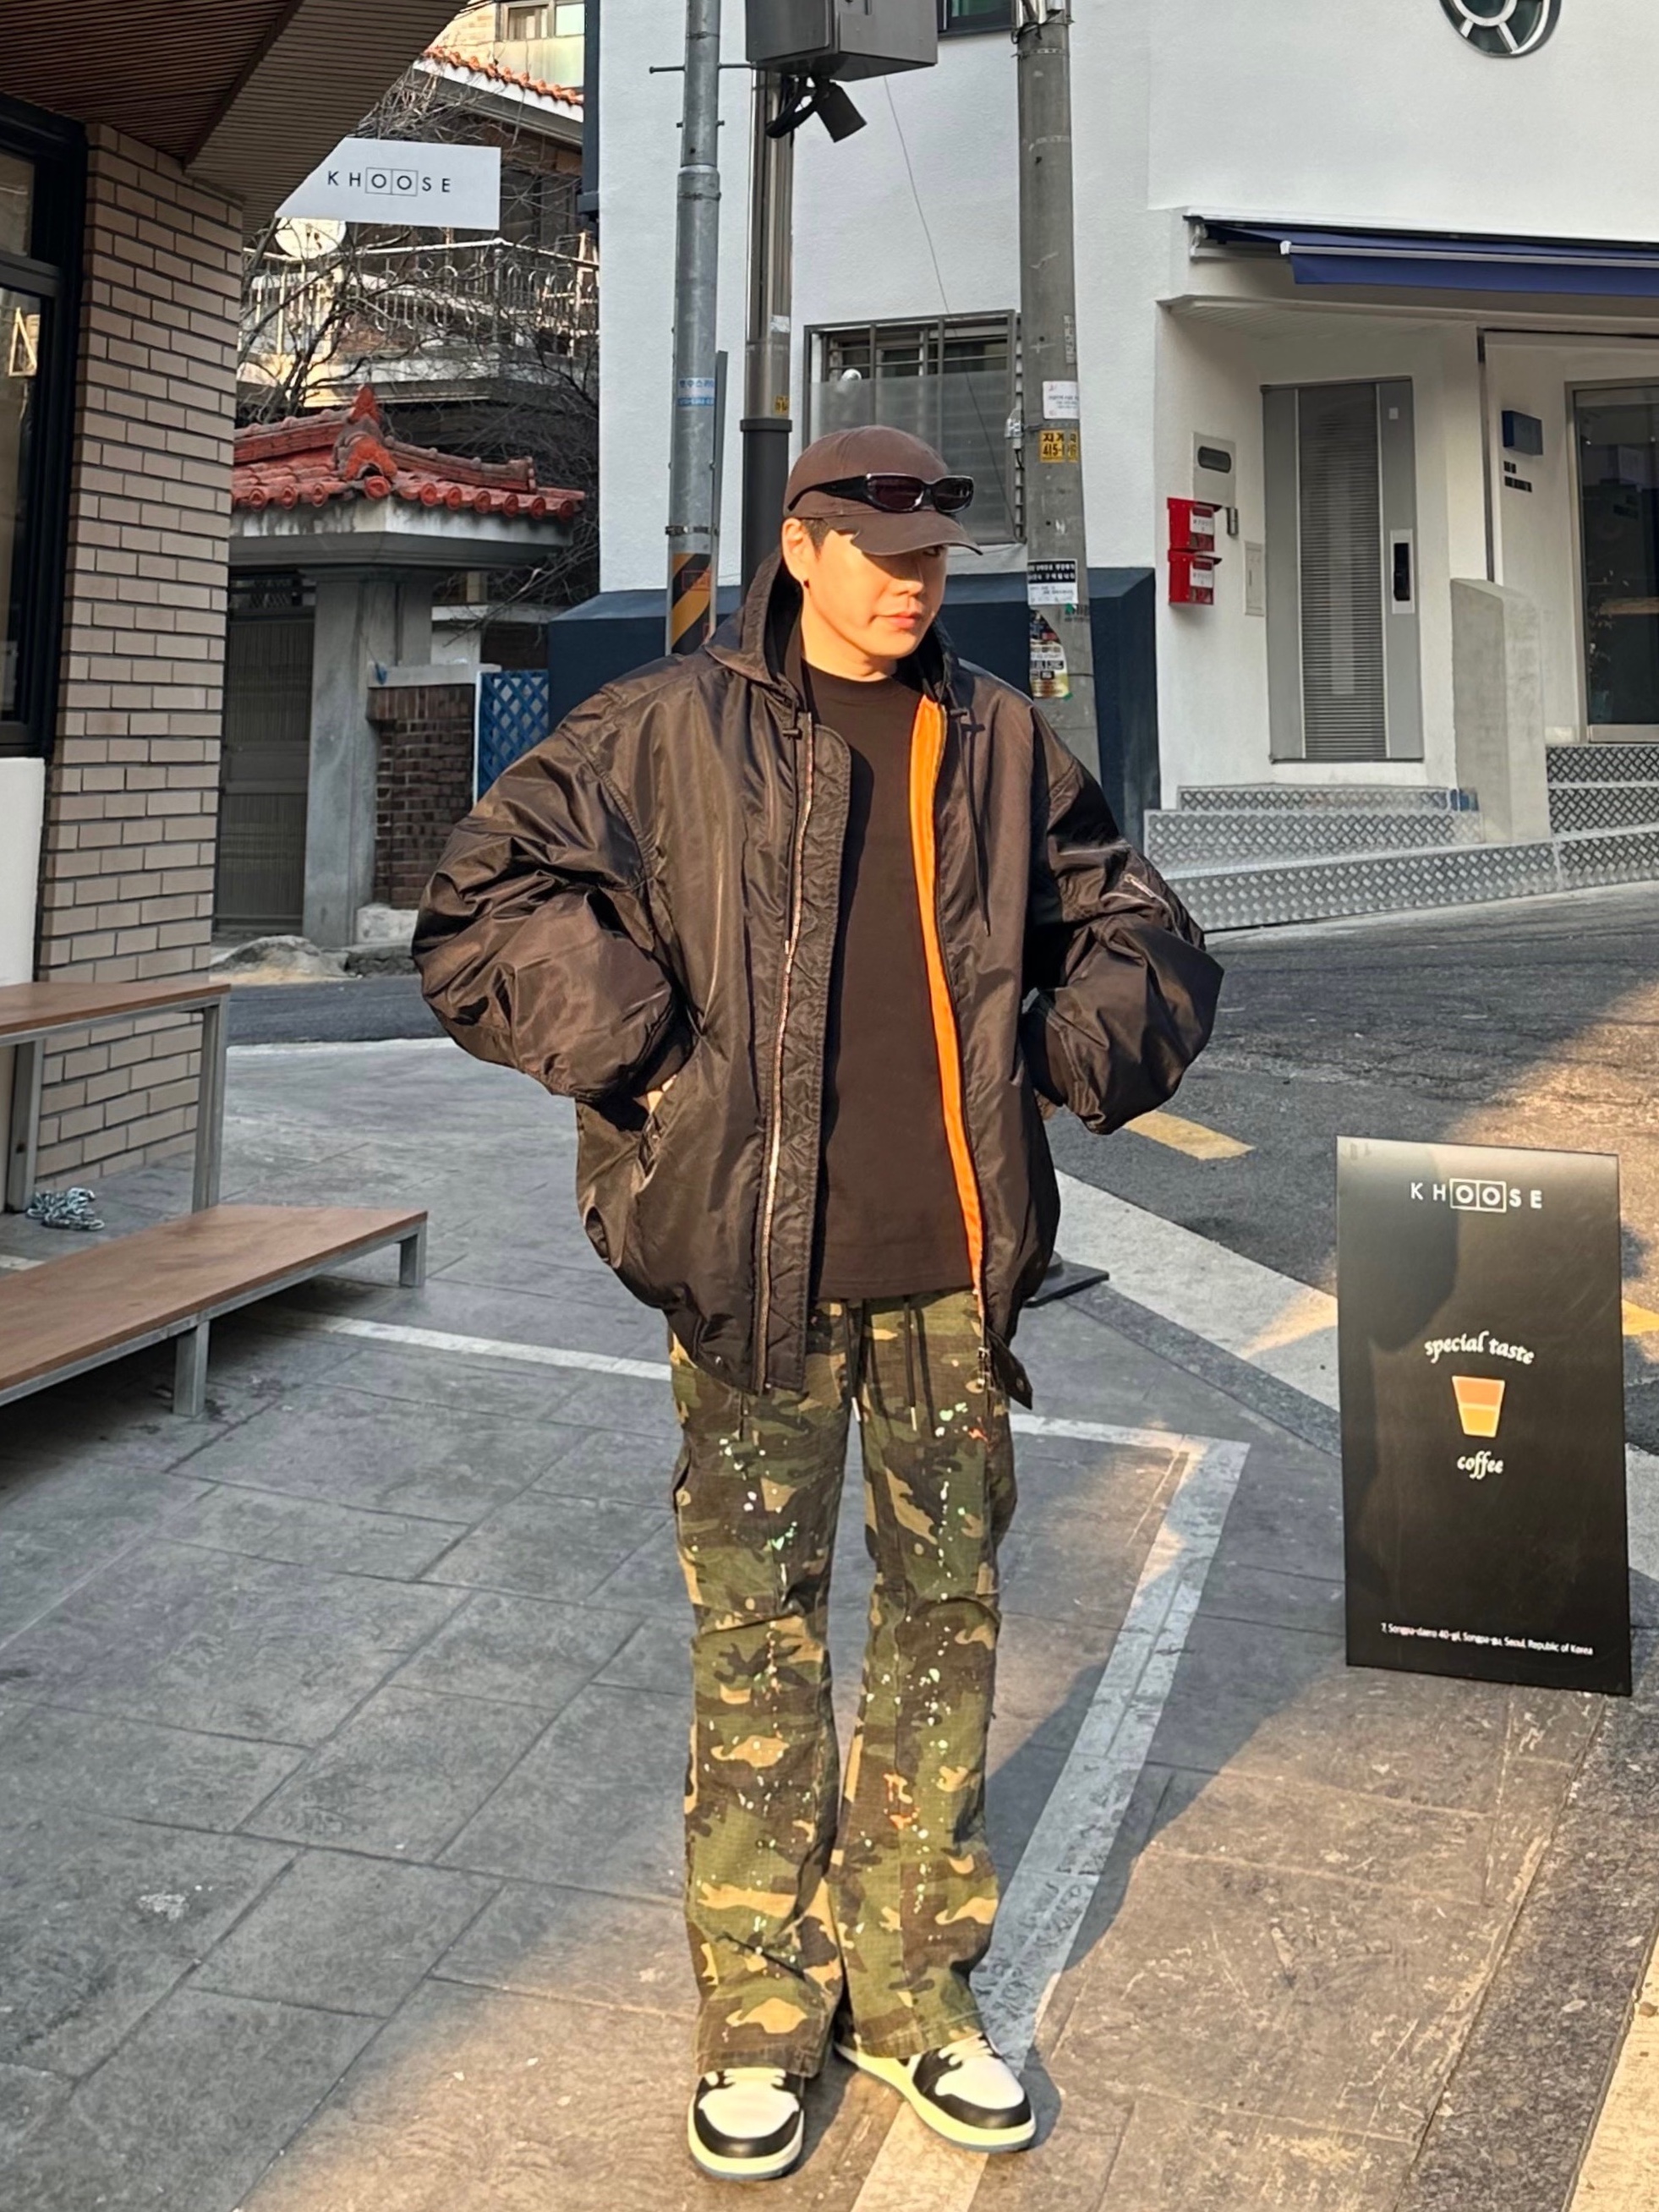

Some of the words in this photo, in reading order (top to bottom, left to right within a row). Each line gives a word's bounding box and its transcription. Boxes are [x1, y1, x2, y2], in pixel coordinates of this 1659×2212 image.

[327, 170, 452, 194] KHOOSE
[1410, 1182, 1542, 1209] KHOOSE
[1424, 1330, 1490, 1364] special
[1488, 1338, 1535, 1365] taste
[1457, 1450, 1503, 1480] coffee
[1561, 1643, 1569, 1652] of
[1570, 1644, 1594, 1656] Korea
